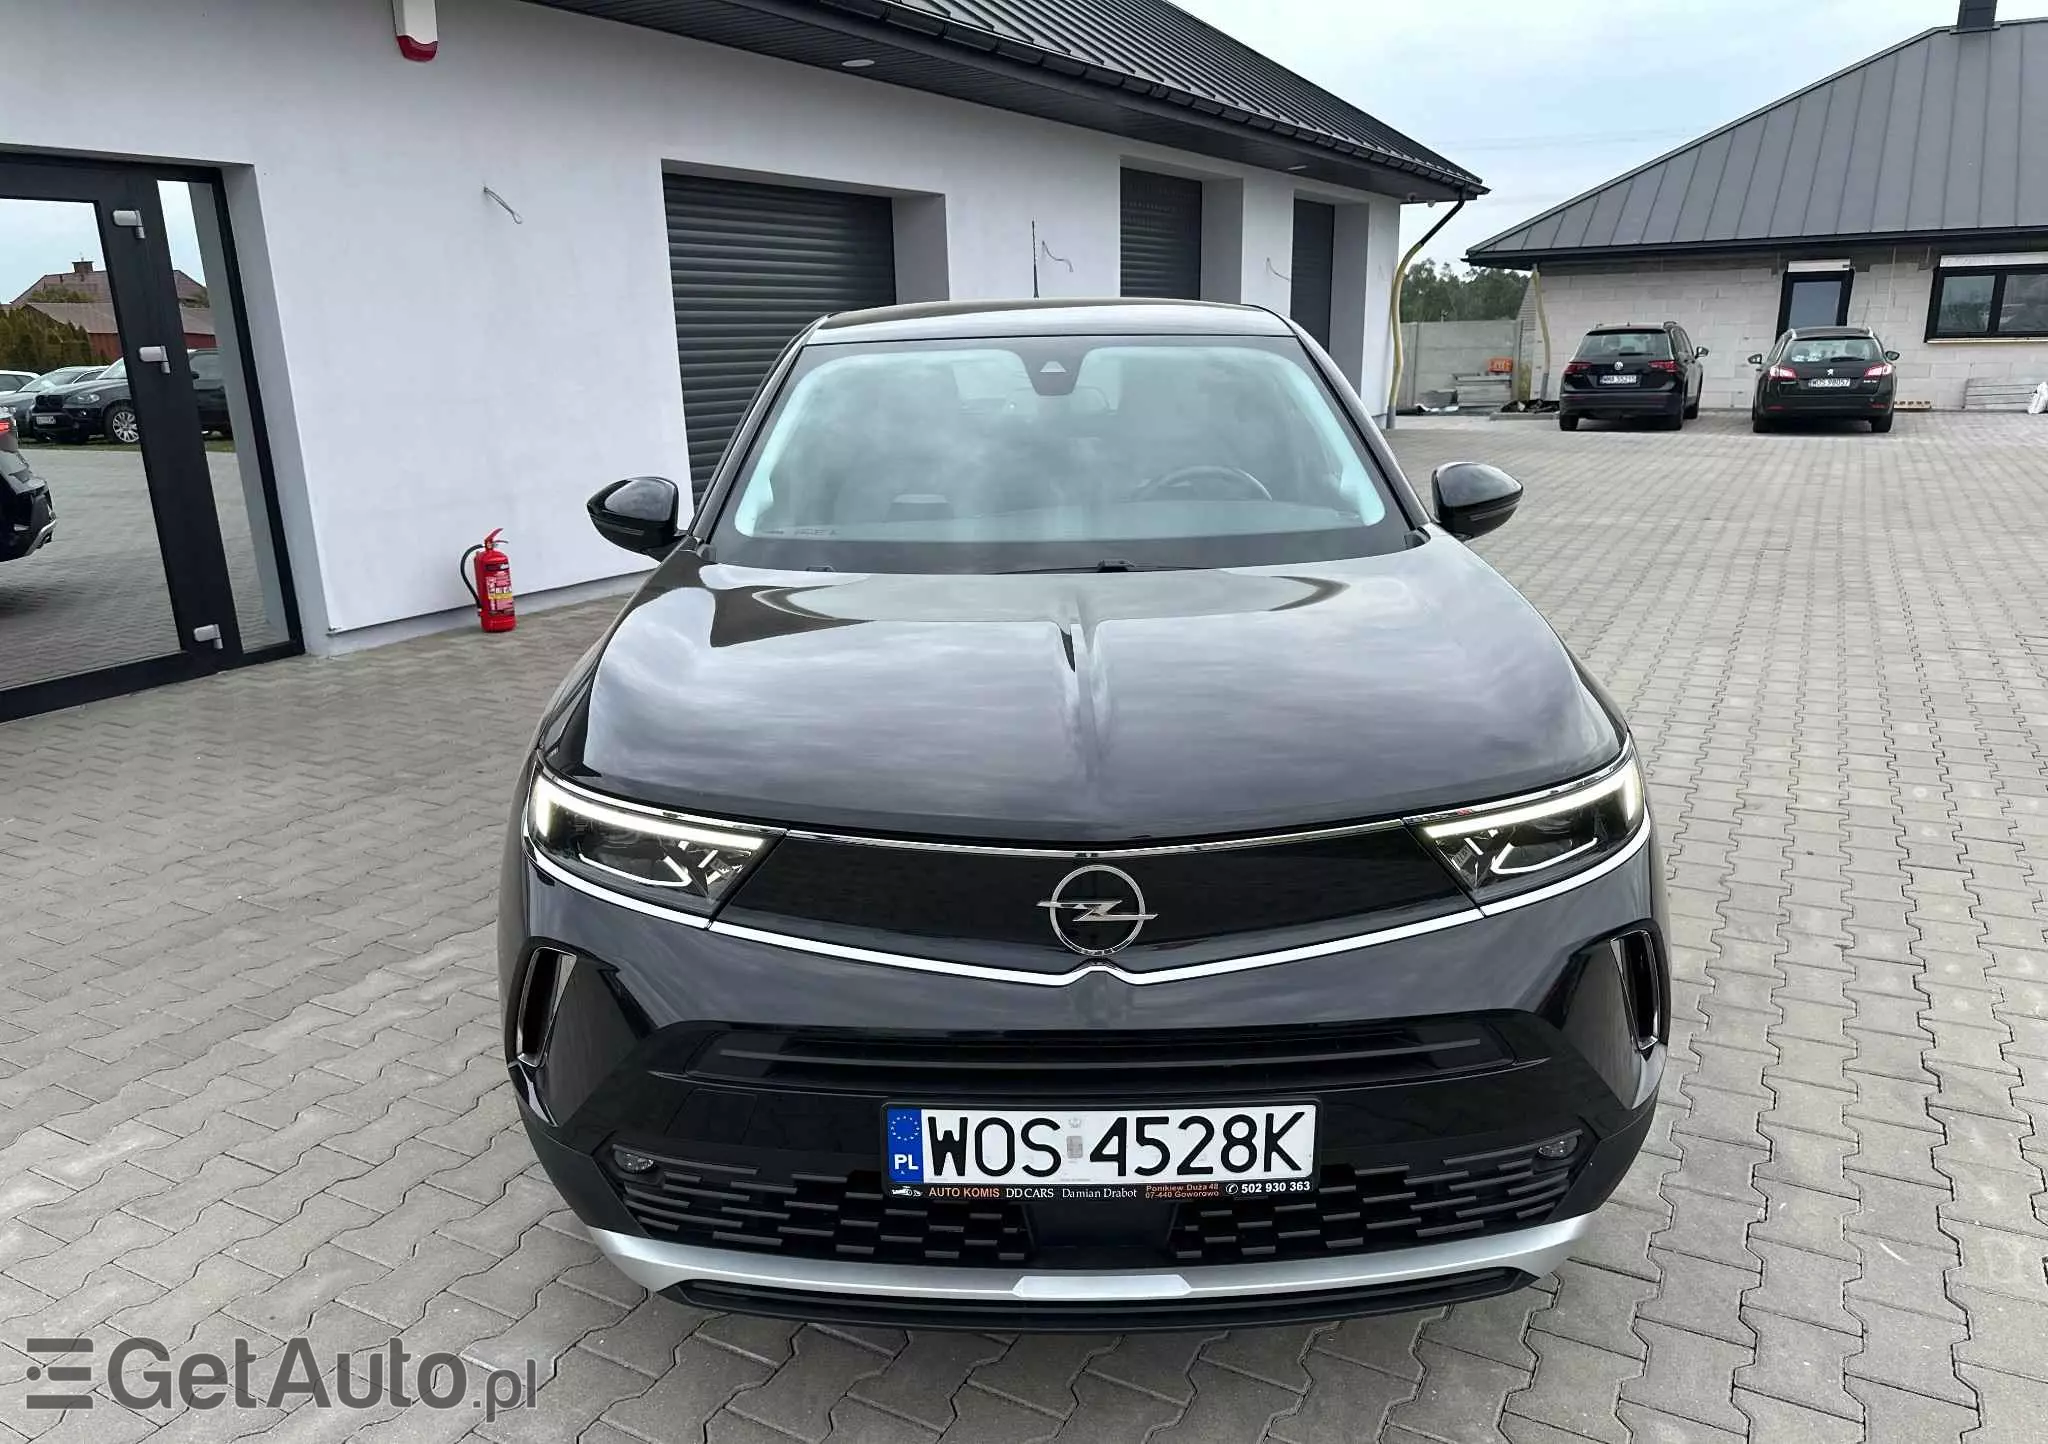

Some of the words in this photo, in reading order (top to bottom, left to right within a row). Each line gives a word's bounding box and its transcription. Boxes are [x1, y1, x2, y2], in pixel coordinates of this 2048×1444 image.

[927, 1116, 1062, 1178] WOS
[1089, 1111, 1305, 1177] 4528K
[894, 1154, 919, 1170] PL
[928, 1187, 960, 1198] AUTO
[963, 1187, 1001, 1198] KOMIS
[1026, 1188, 1054, 1198] CARS
[1062, 1188, 1101, 1199] Damian
[1103, 1188, 1137, 1199] Drabot
[1174, 1190, 1219, 1198] Goworowo
[1241, 1184, 1262, 1194] 502
[1265, 1182, 1286, 1193] 930
[1289, 1181, 1311, 1192] 363
